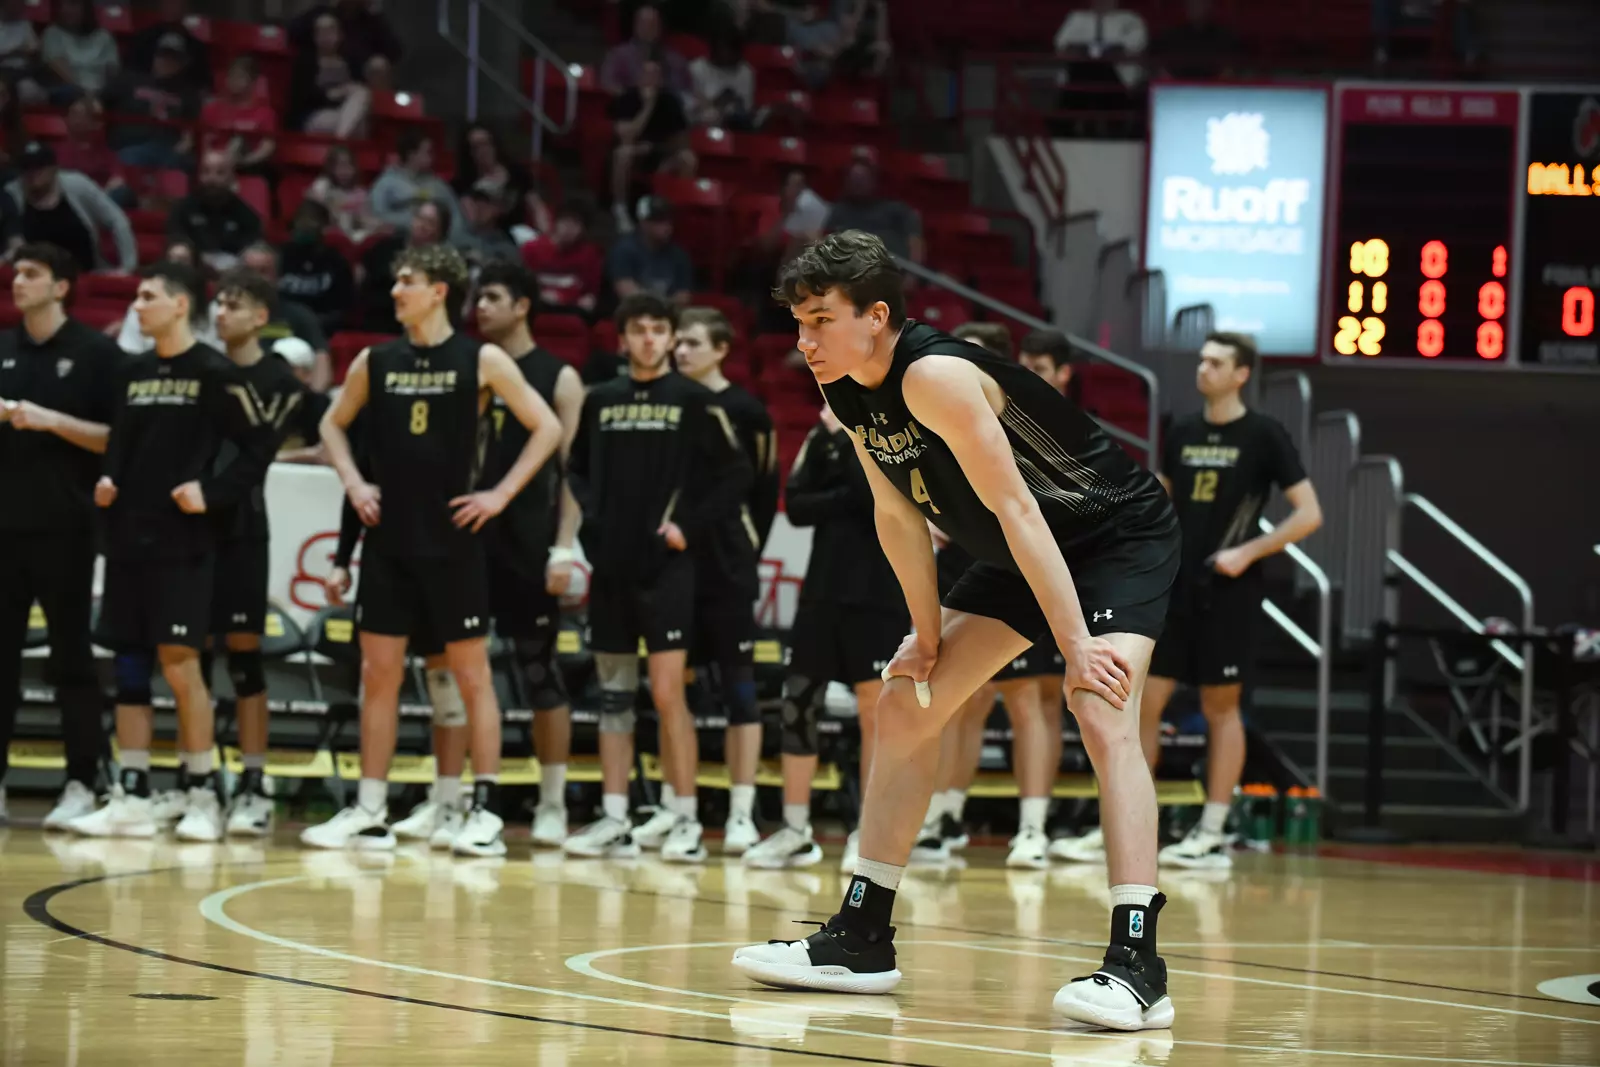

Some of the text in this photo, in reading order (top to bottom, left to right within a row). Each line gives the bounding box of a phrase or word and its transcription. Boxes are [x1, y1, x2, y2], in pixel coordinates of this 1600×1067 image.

[1162, 175, 1310, 224] Ruoff
[1420, 240, 1448, 279] 0
[1492, 244, 1507, 278] 1
[1348, 279, 1505, 320] 11 0 0
[1562, 286, 1595, 337] 0
[1334, 315, 1386, 356] 22
[1417, 318, 1444, 358] 0
[1476, 320, 1503, 359] 0
[127, 378, 201, 398] PURDUE
[385, 370, 458, 387] PURDUE
[409, 400, 430, 435] 8
[600, 403, 683, 424] PURDUE
[910, 467, 941, 514] 4
[1190, 469, 1219, 501] 12
